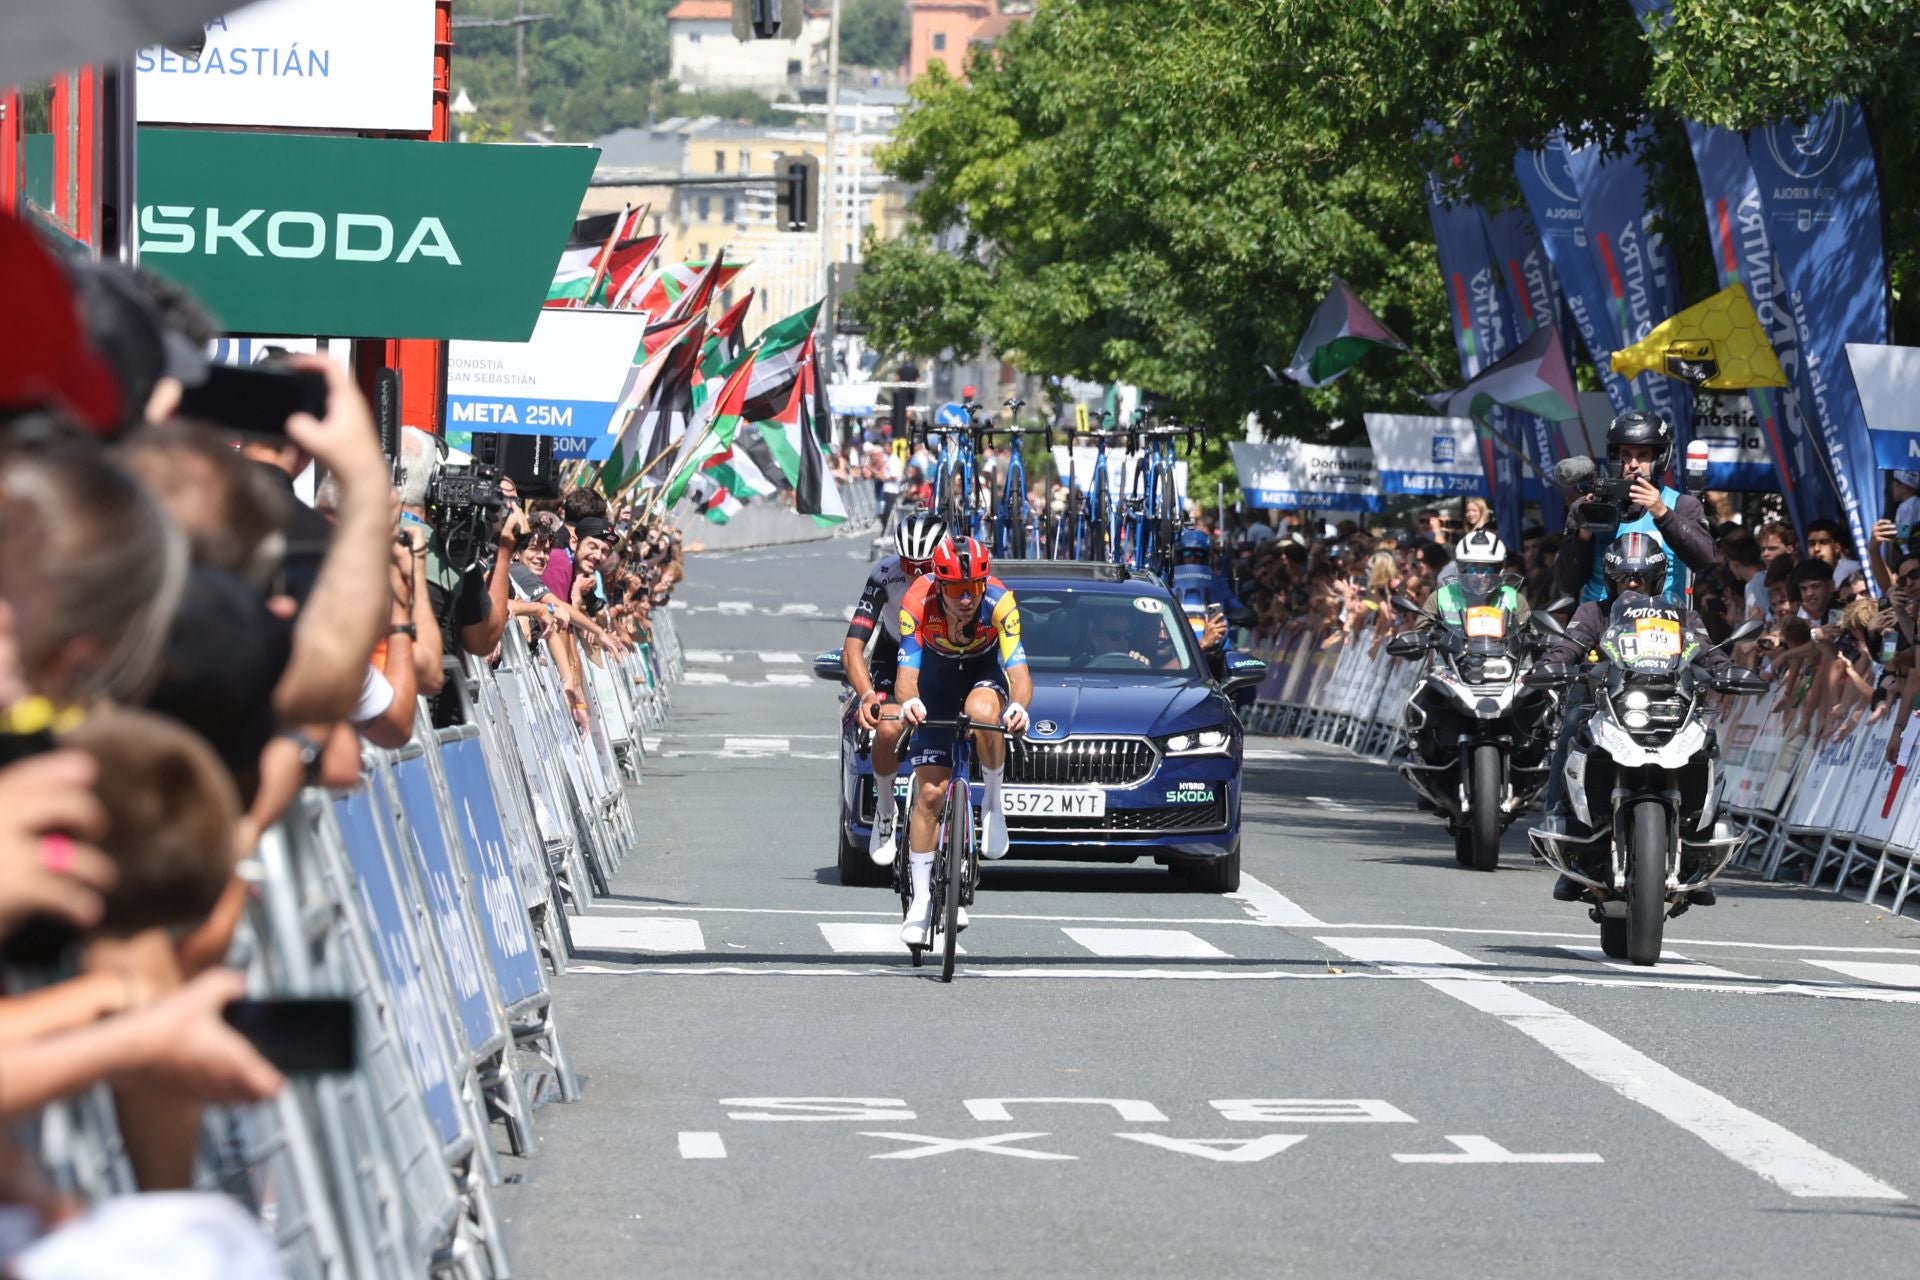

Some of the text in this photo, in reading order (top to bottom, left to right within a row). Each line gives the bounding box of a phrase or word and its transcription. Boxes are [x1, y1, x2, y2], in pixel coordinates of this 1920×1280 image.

[136, 42, 329, 77] SEBASTIÁN
[447, 371, 537, 386] SAN SEBASTIÁN
[452, 401, 573, 427] META 25M
[1402, 474, 1479, 492] META 75M
[1261, 489, 1297, 505] META
[1623, 606, 1679, 620] MOTOS TV
[1650, 632, 1668, 645] 99
[1620, 638, 1639, 656] H
[1634, 659, 1669, 669] MOTOS TV
[1179, 782, 1206, 791] HYBRID
[1003, 793, 1099, 813] 5572 MYT
